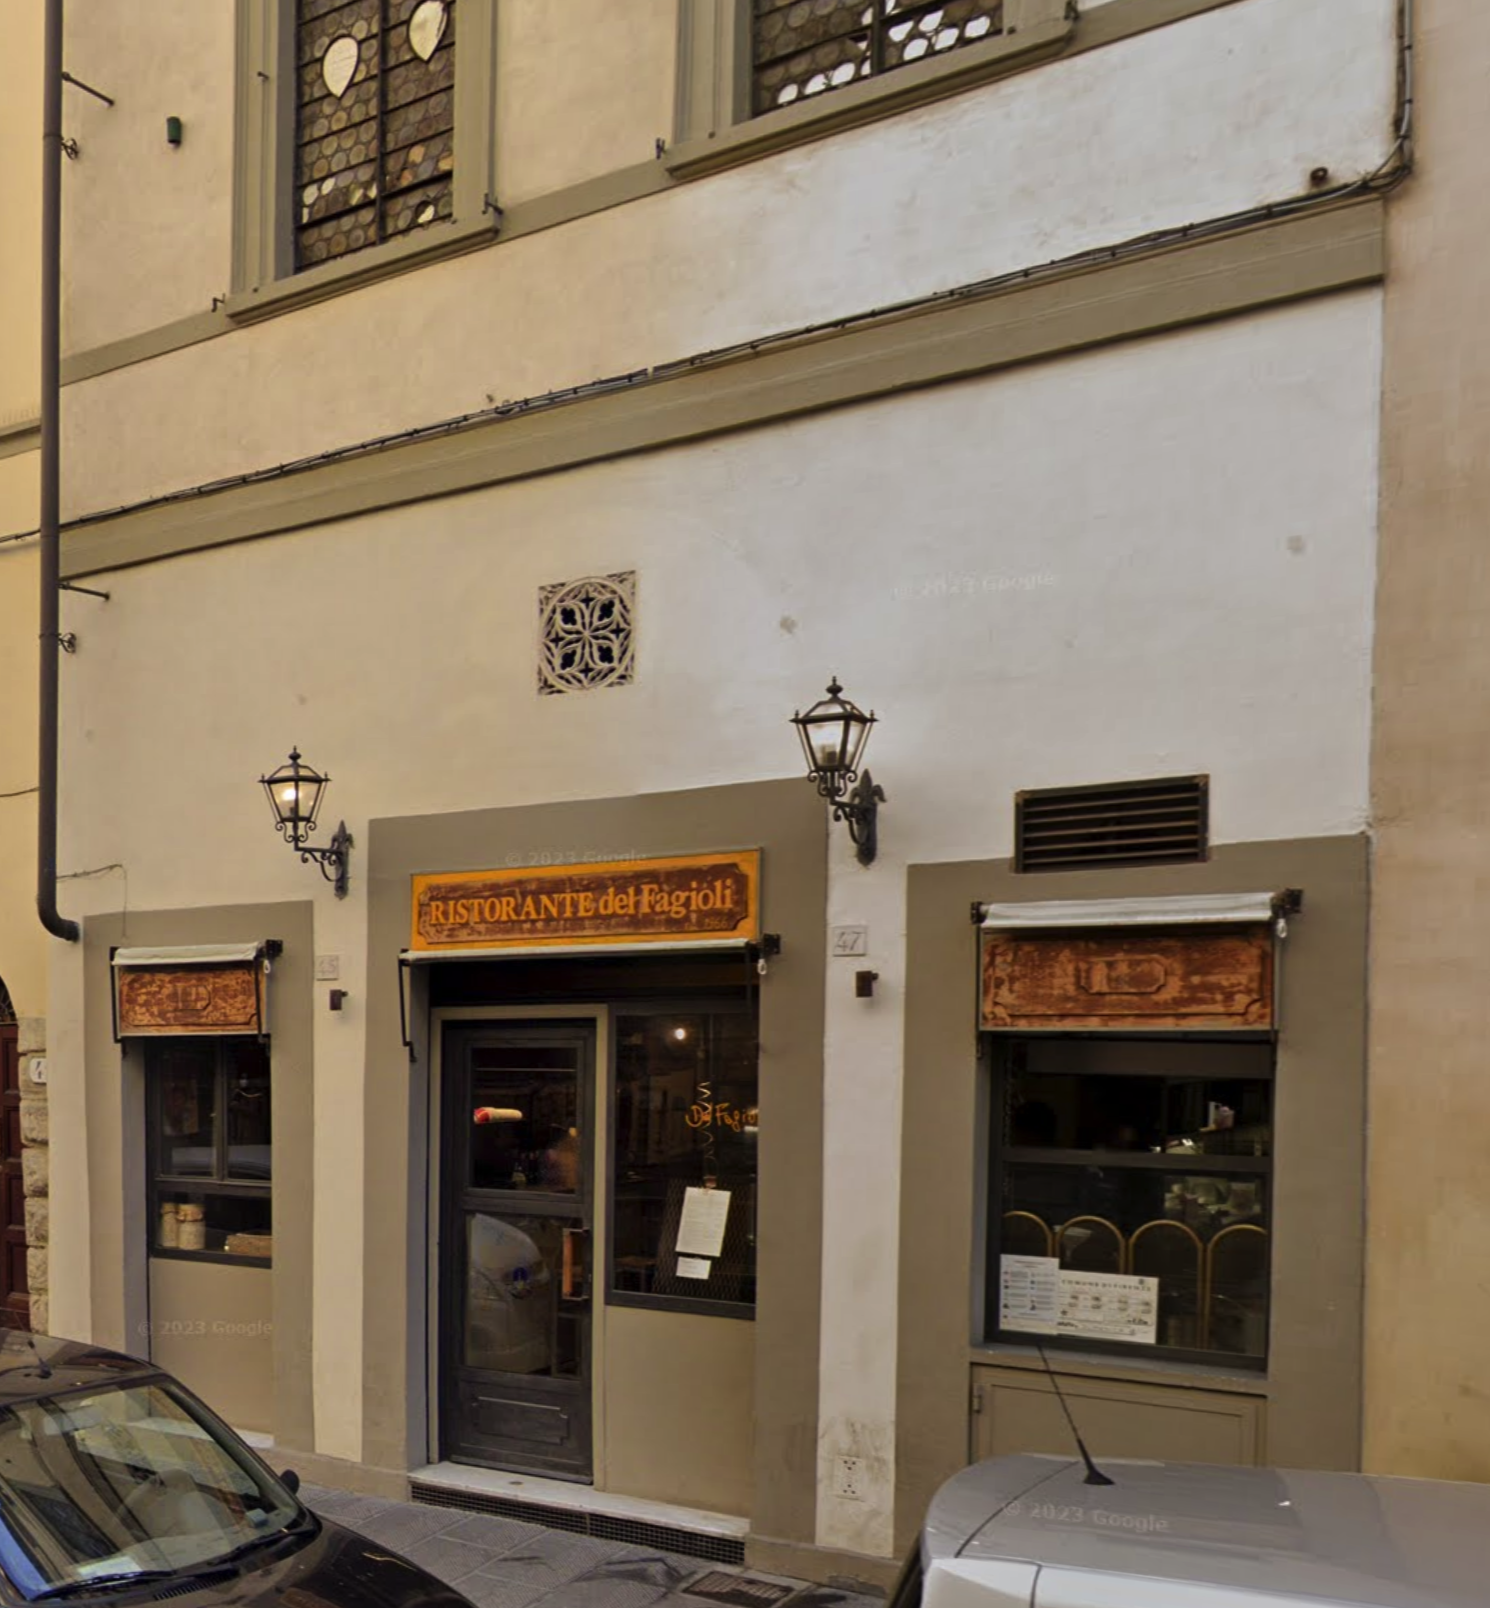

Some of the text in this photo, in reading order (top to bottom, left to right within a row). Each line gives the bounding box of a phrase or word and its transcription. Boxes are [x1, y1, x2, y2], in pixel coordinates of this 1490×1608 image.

[429, 878, 733, 925] RISTORANTE del Fagioli
[835, 930, 866, 952] 47
